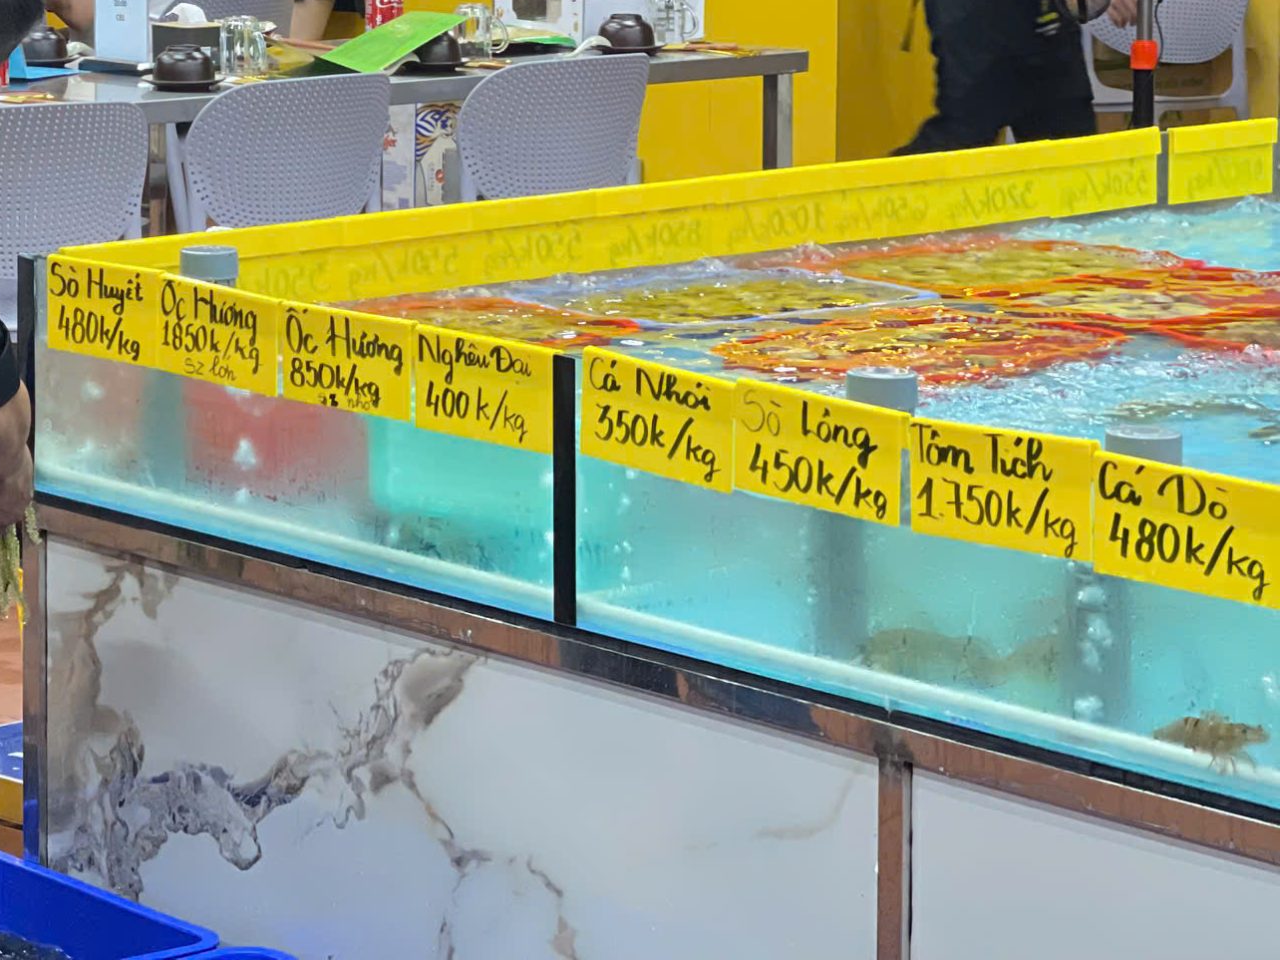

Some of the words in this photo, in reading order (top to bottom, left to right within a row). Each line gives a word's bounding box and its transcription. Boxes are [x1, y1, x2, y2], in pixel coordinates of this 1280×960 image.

[49, 261, 80, 298] Sò
[57, 304, 141, 362] 480k/kg
[161, 319, 263, 376] 1850k/kg
[289, 356, 382, 409] 850k/kg
[589, 356, 622, 393] Cá
[740, 388, 782, 437] Sò
[594, 402, 723, 484] 350k/kg
[910, 422, 976, 475] Tôm
[981, 432, 1054, 483] Tích
[748, 441, 888, 521] 450k/kg
[1097, 459, 1147, 507] Cá
[1108, 511, 1271, 602] 480k/kg
